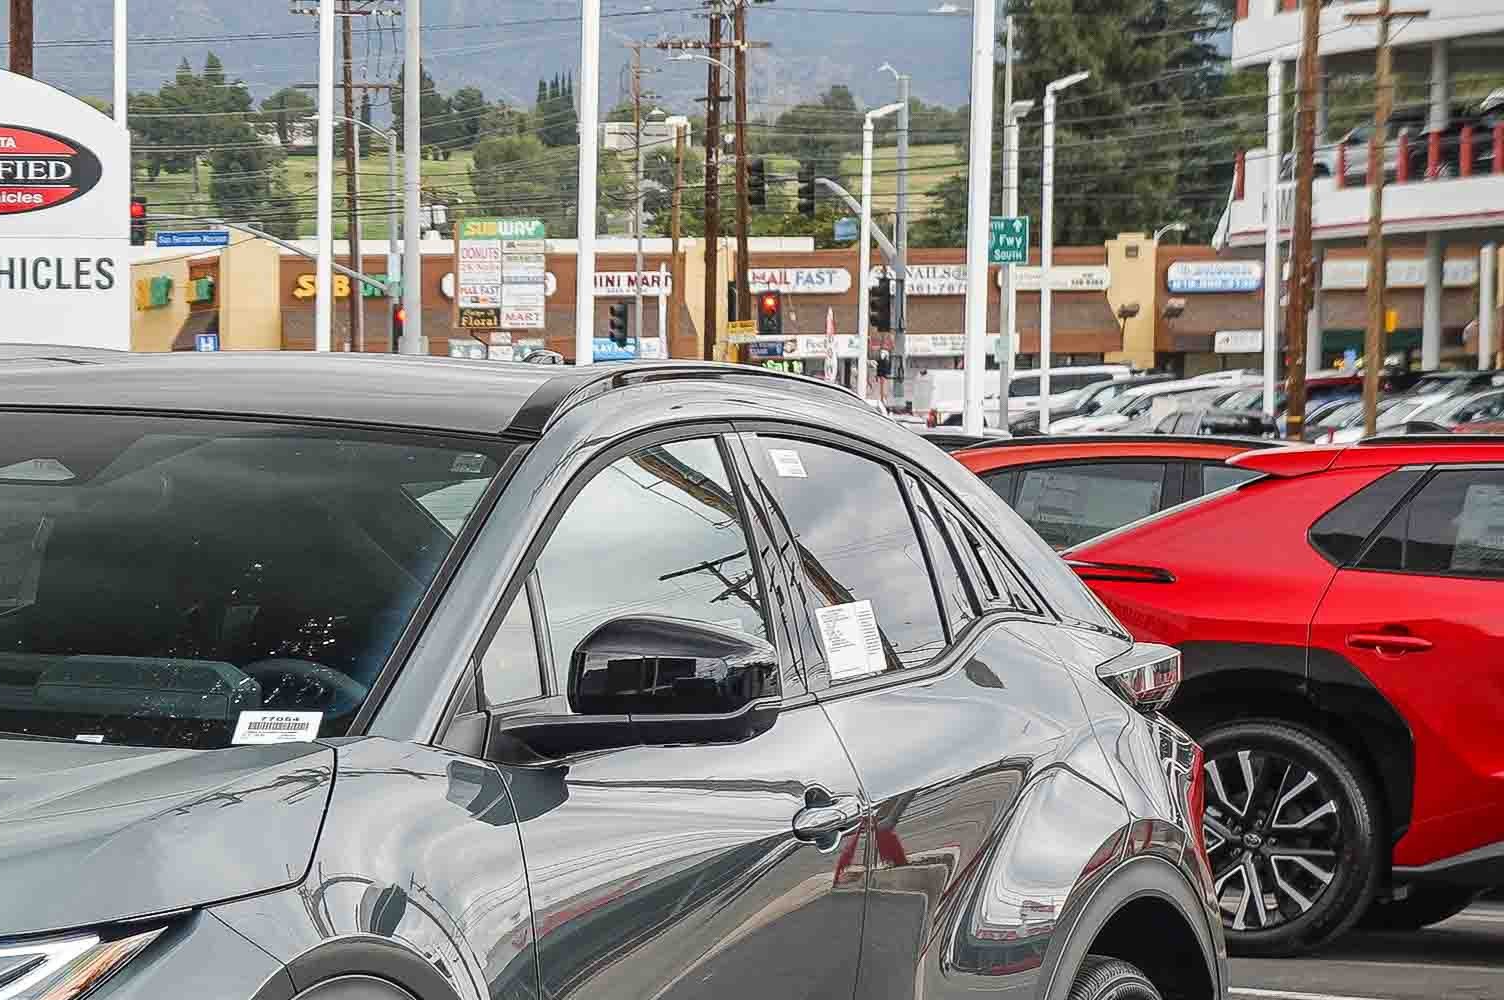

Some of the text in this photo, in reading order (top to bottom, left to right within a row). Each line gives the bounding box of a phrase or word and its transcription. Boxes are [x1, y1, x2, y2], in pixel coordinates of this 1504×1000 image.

[999, 233, 1023, 248] Fwy
[751, 270, 837, 286] MAIL FAST
[199, 336, 214, 352] H
